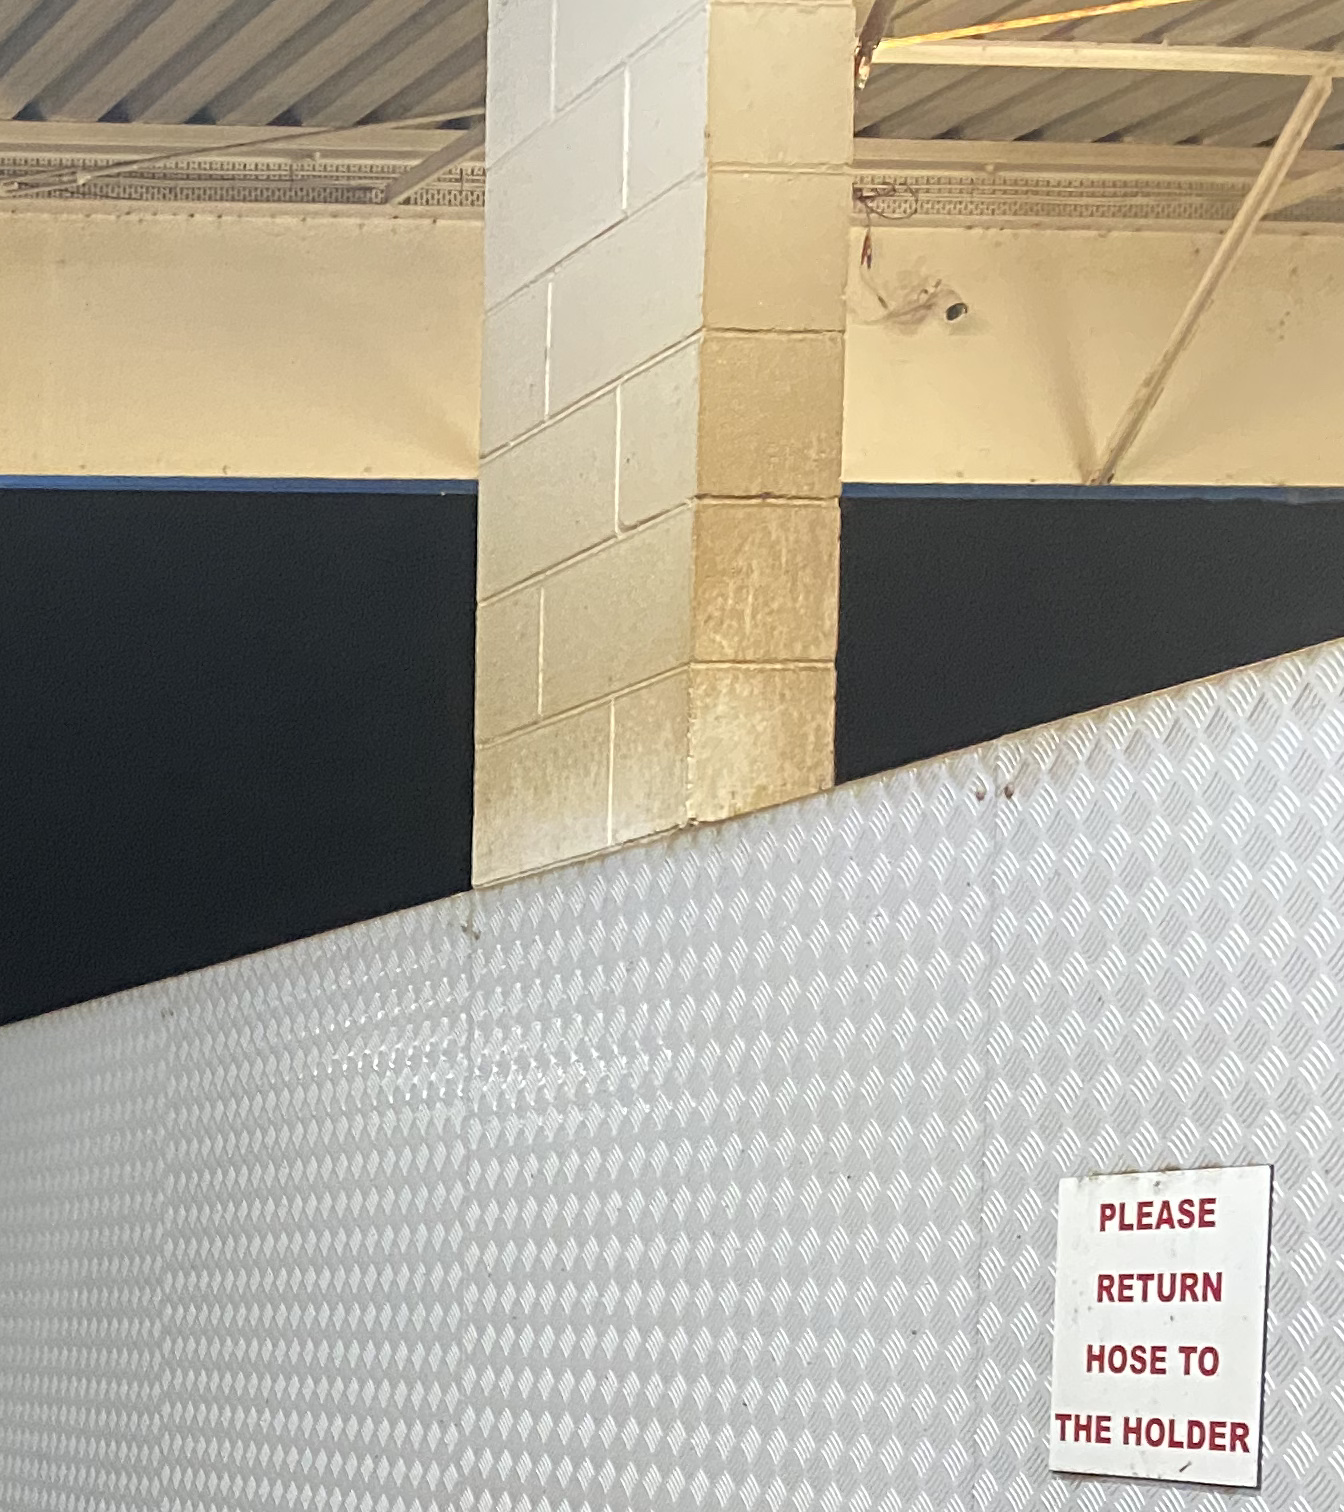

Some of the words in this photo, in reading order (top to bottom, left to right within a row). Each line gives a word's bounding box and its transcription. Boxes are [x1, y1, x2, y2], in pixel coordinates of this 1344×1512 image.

[1099, 1197, 1217, 1232] PLEASE
[1096, 1272, 1223, 1303] RETURN
[1086, 1344, 1168, 1375] HOSE
[1178, 1346, 1220, 1377] TO
[1055, 1413, 1112, 1444] THE
[1122, 1416, 1251, 1453] HOLDER
